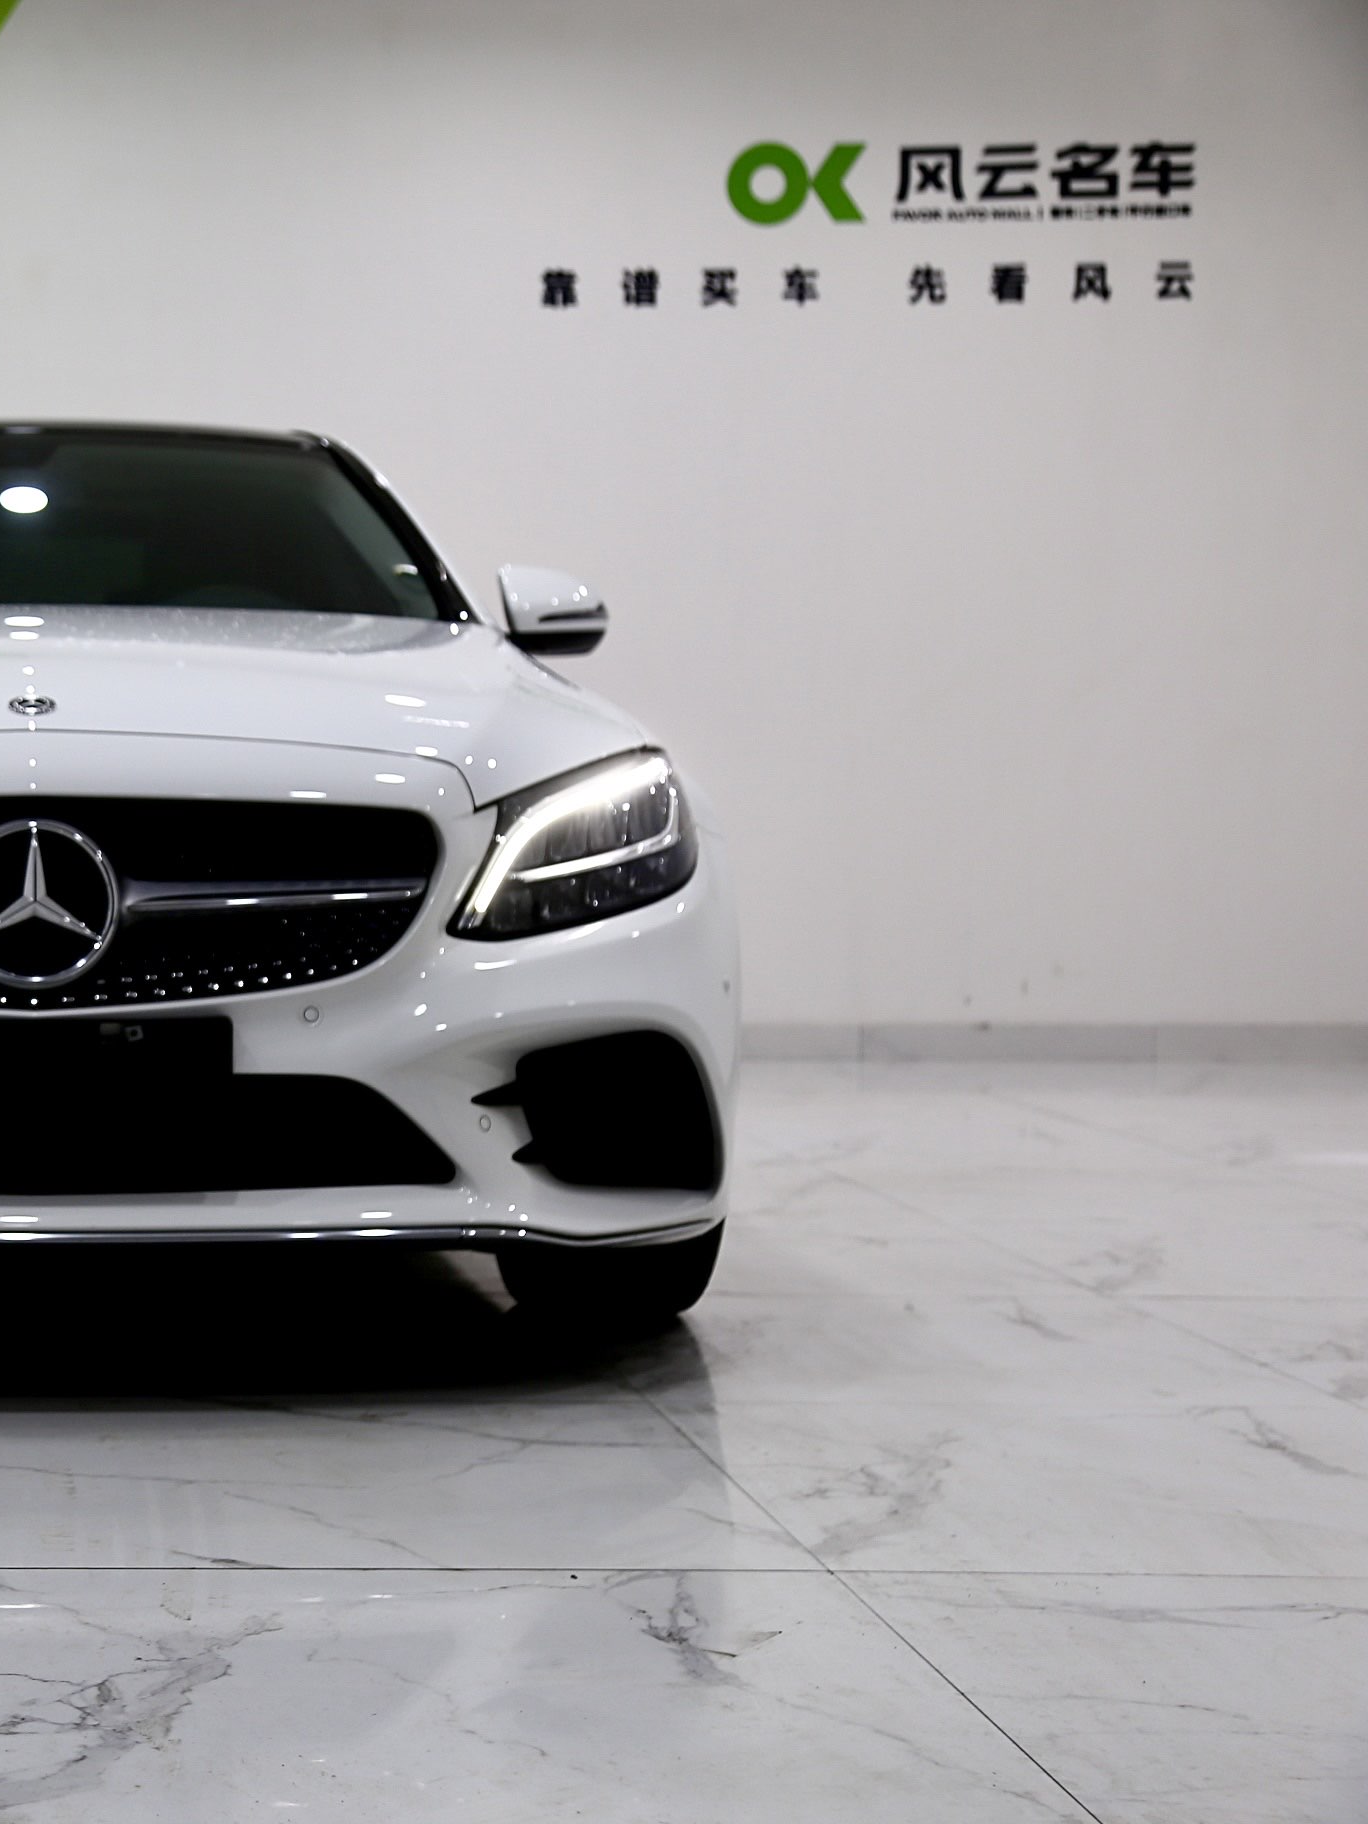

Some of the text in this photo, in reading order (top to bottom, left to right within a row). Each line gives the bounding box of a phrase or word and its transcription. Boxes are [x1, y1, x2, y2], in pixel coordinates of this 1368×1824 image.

[727, 141, 866, 226] OK
[895, 141, 1198, 202] 风云名车
[542, 261, 1194, 308] 靠谱买车 先看风云
